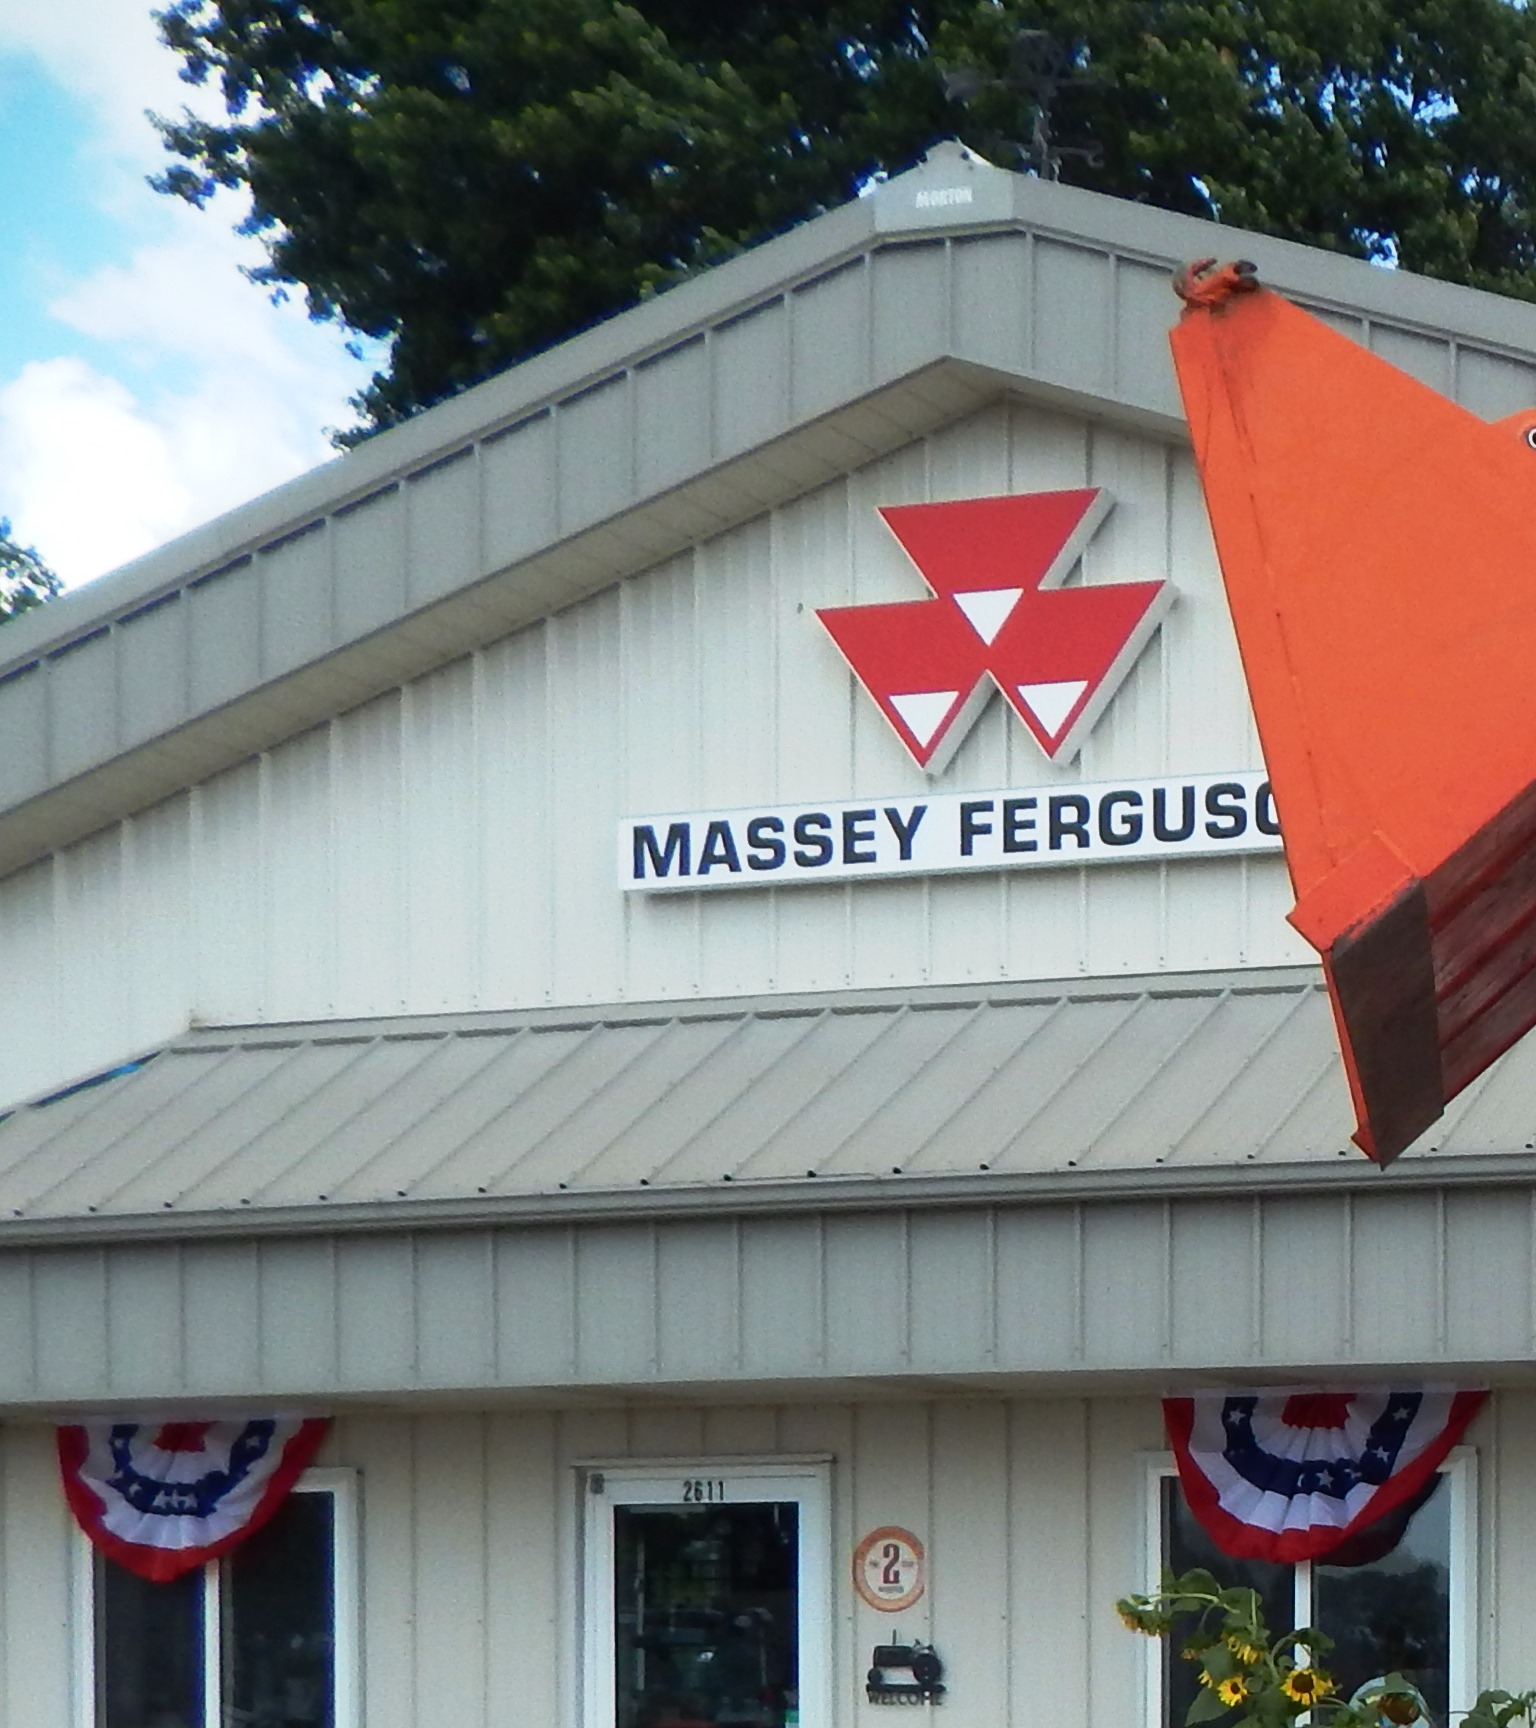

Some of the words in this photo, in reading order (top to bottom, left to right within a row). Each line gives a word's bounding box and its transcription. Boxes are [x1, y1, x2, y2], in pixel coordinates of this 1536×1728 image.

[633, 805, 927, 879] MASSEY
[683, 1480, 724, 1501] 2611
[883, 1543, 900, 1584] 2
